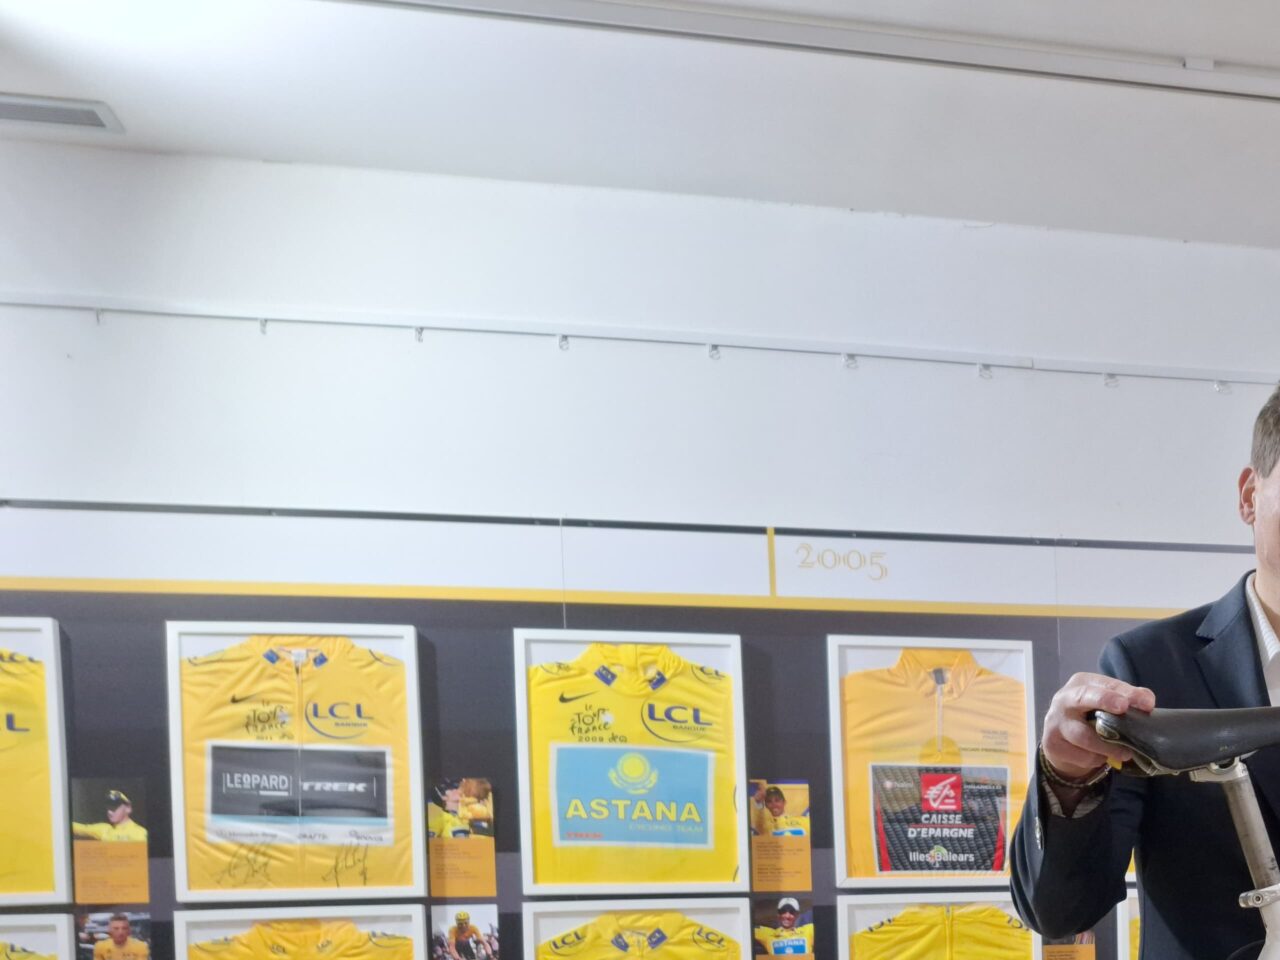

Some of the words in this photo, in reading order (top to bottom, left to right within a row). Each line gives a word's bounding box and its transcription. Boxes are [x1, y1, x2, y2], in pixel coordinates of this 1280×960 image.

[795, 544, 888, 581] 2005
[311, 702, 374, 720] LCL
[647, 703, 713, 726] LCL
[226, 772, 289, 790] LEOPARD
[301, 781, 368, 793] TREK
[565, 798, 703, 823] ASTANA
[921, 813, 962, 824] CAISSE
[908, 828, 975, 839] D'EPARGNE
[909, 851, 933, 862] Illes
[934, 851, 975, 862] Balears
[552, 930, 587, 949] LCL
[696, 927, 725, 946] LCL
